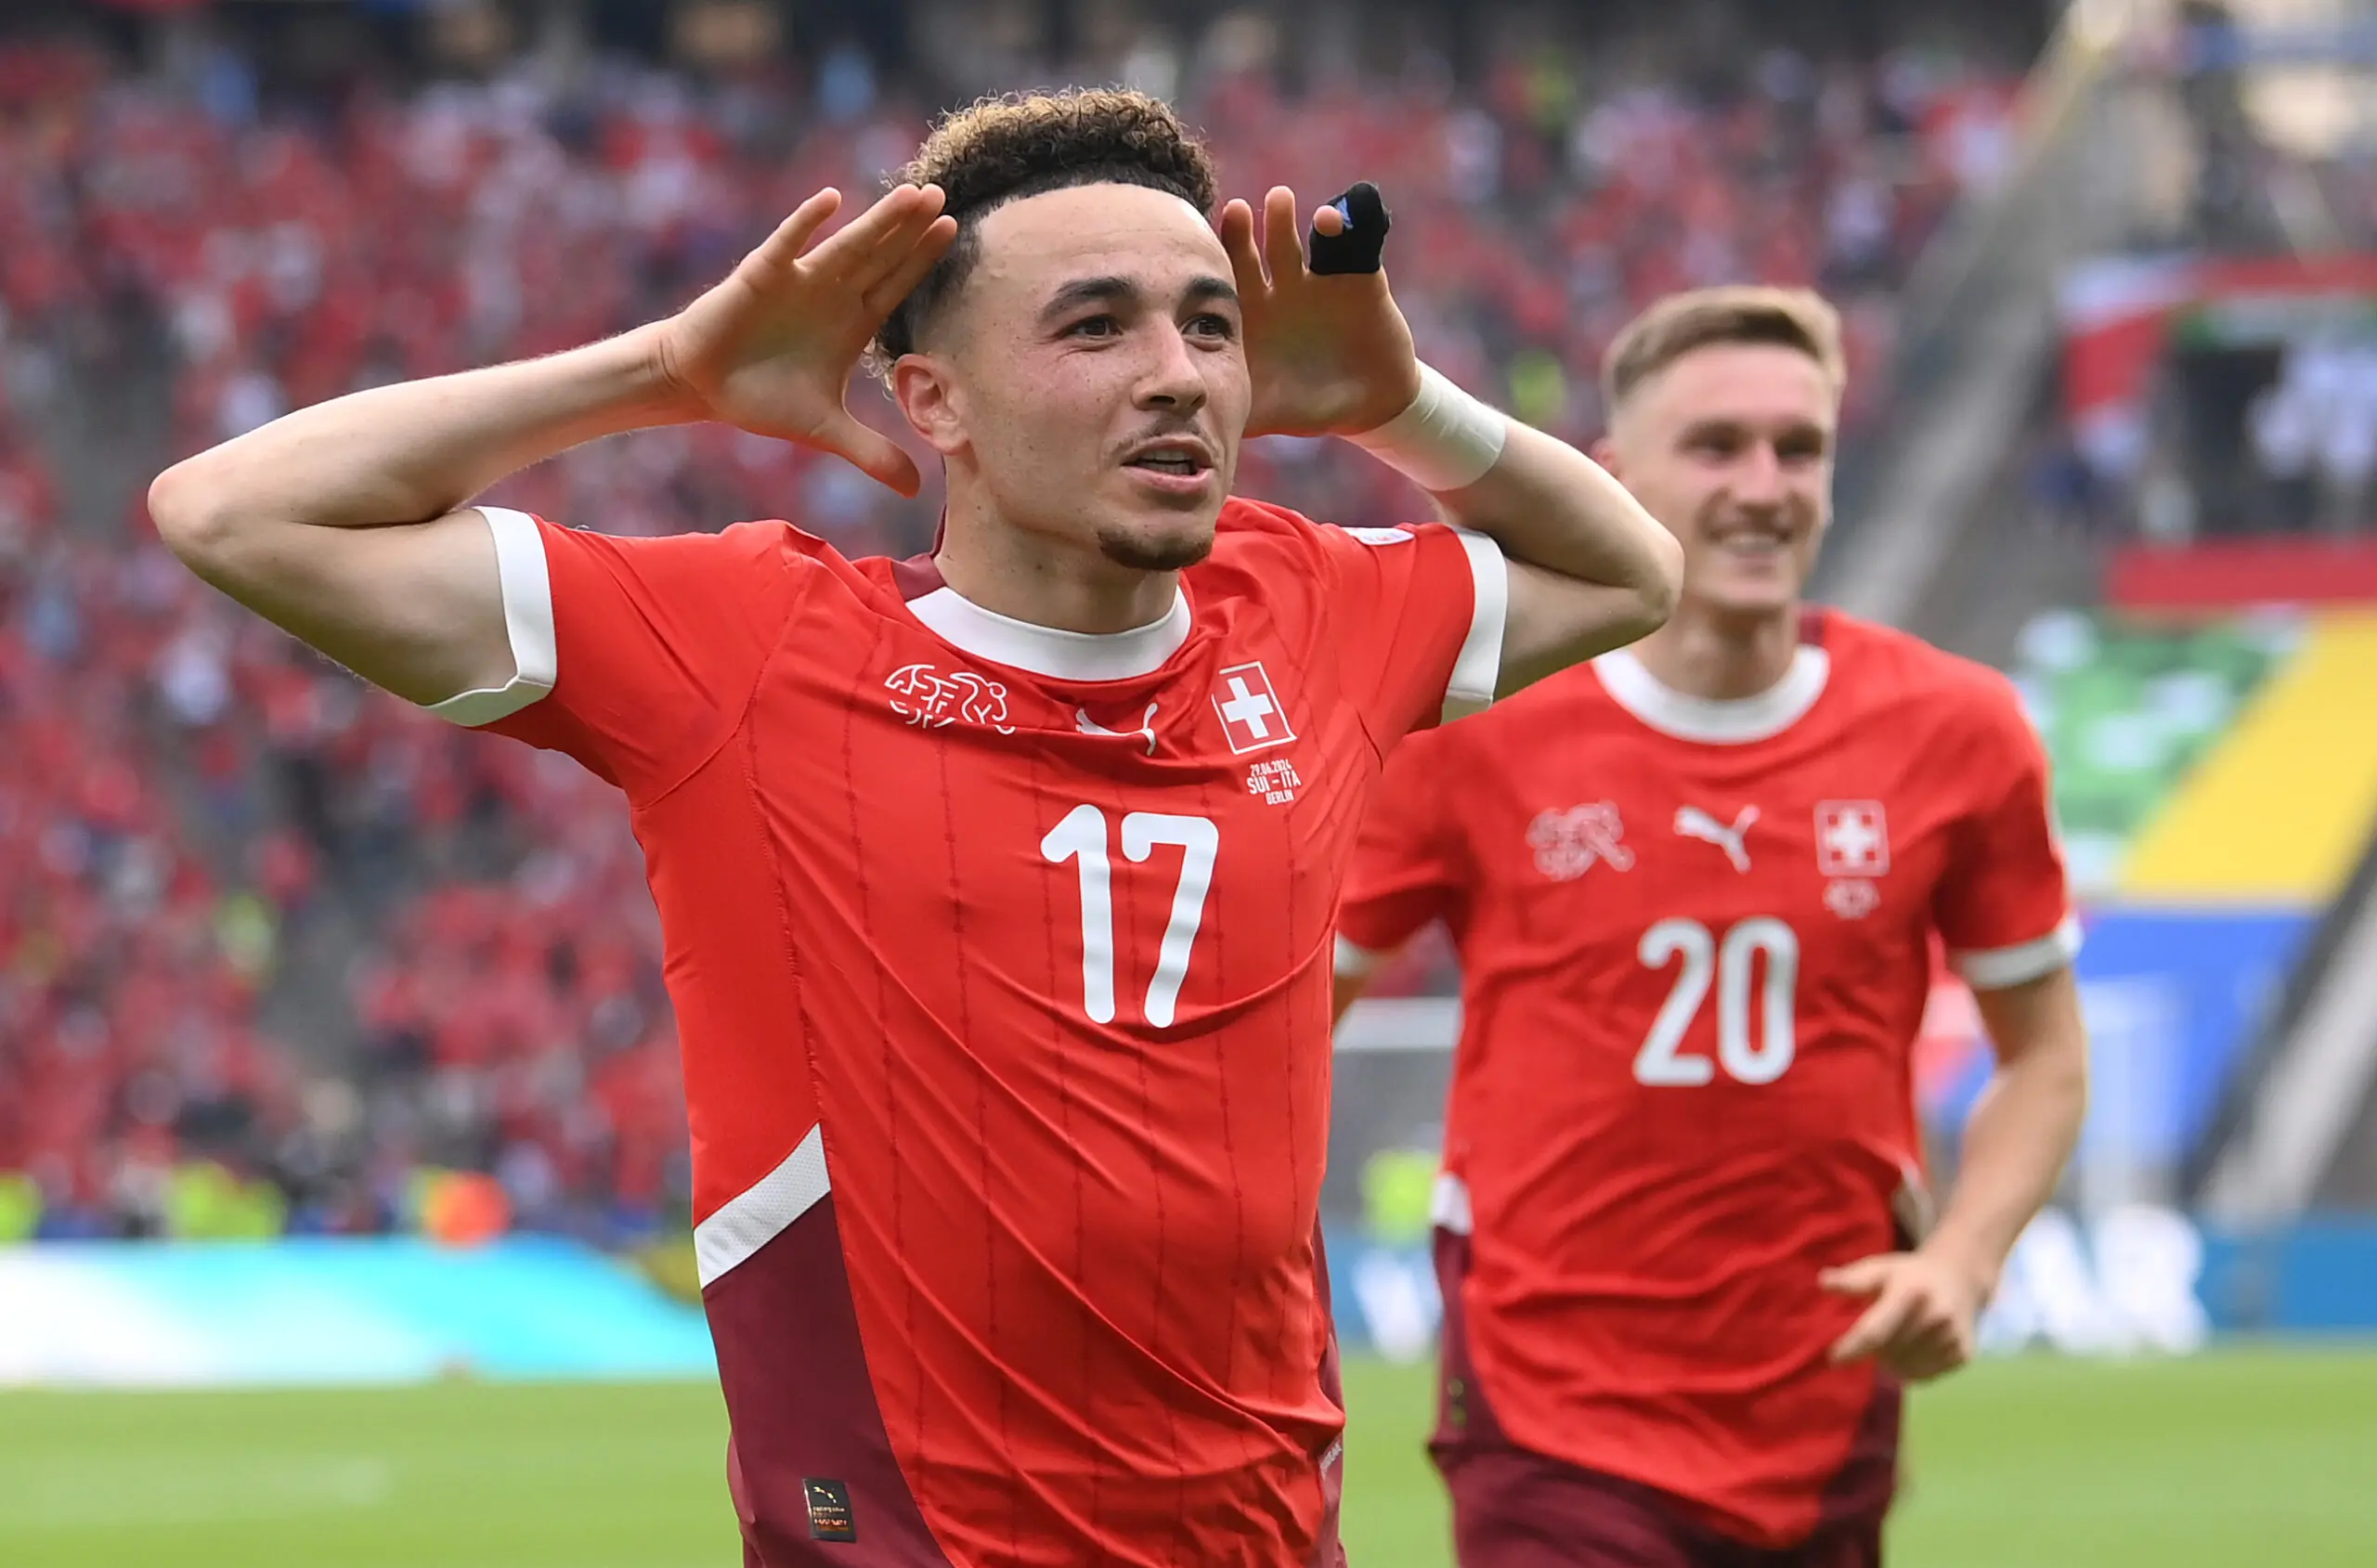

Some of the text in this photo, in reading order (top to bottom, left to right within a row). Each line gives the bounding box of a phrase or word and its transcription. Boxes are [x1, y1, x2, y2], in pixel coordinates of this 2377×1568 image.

[1247, 776, 1270, 795] SUI
[1280, 770, 1302, 787] ITA
[1266, 789, 1294, 805] BERLIN
[1040, 804, 1219, 1028] 17
[1633, 916, 1799, 1086] 20
